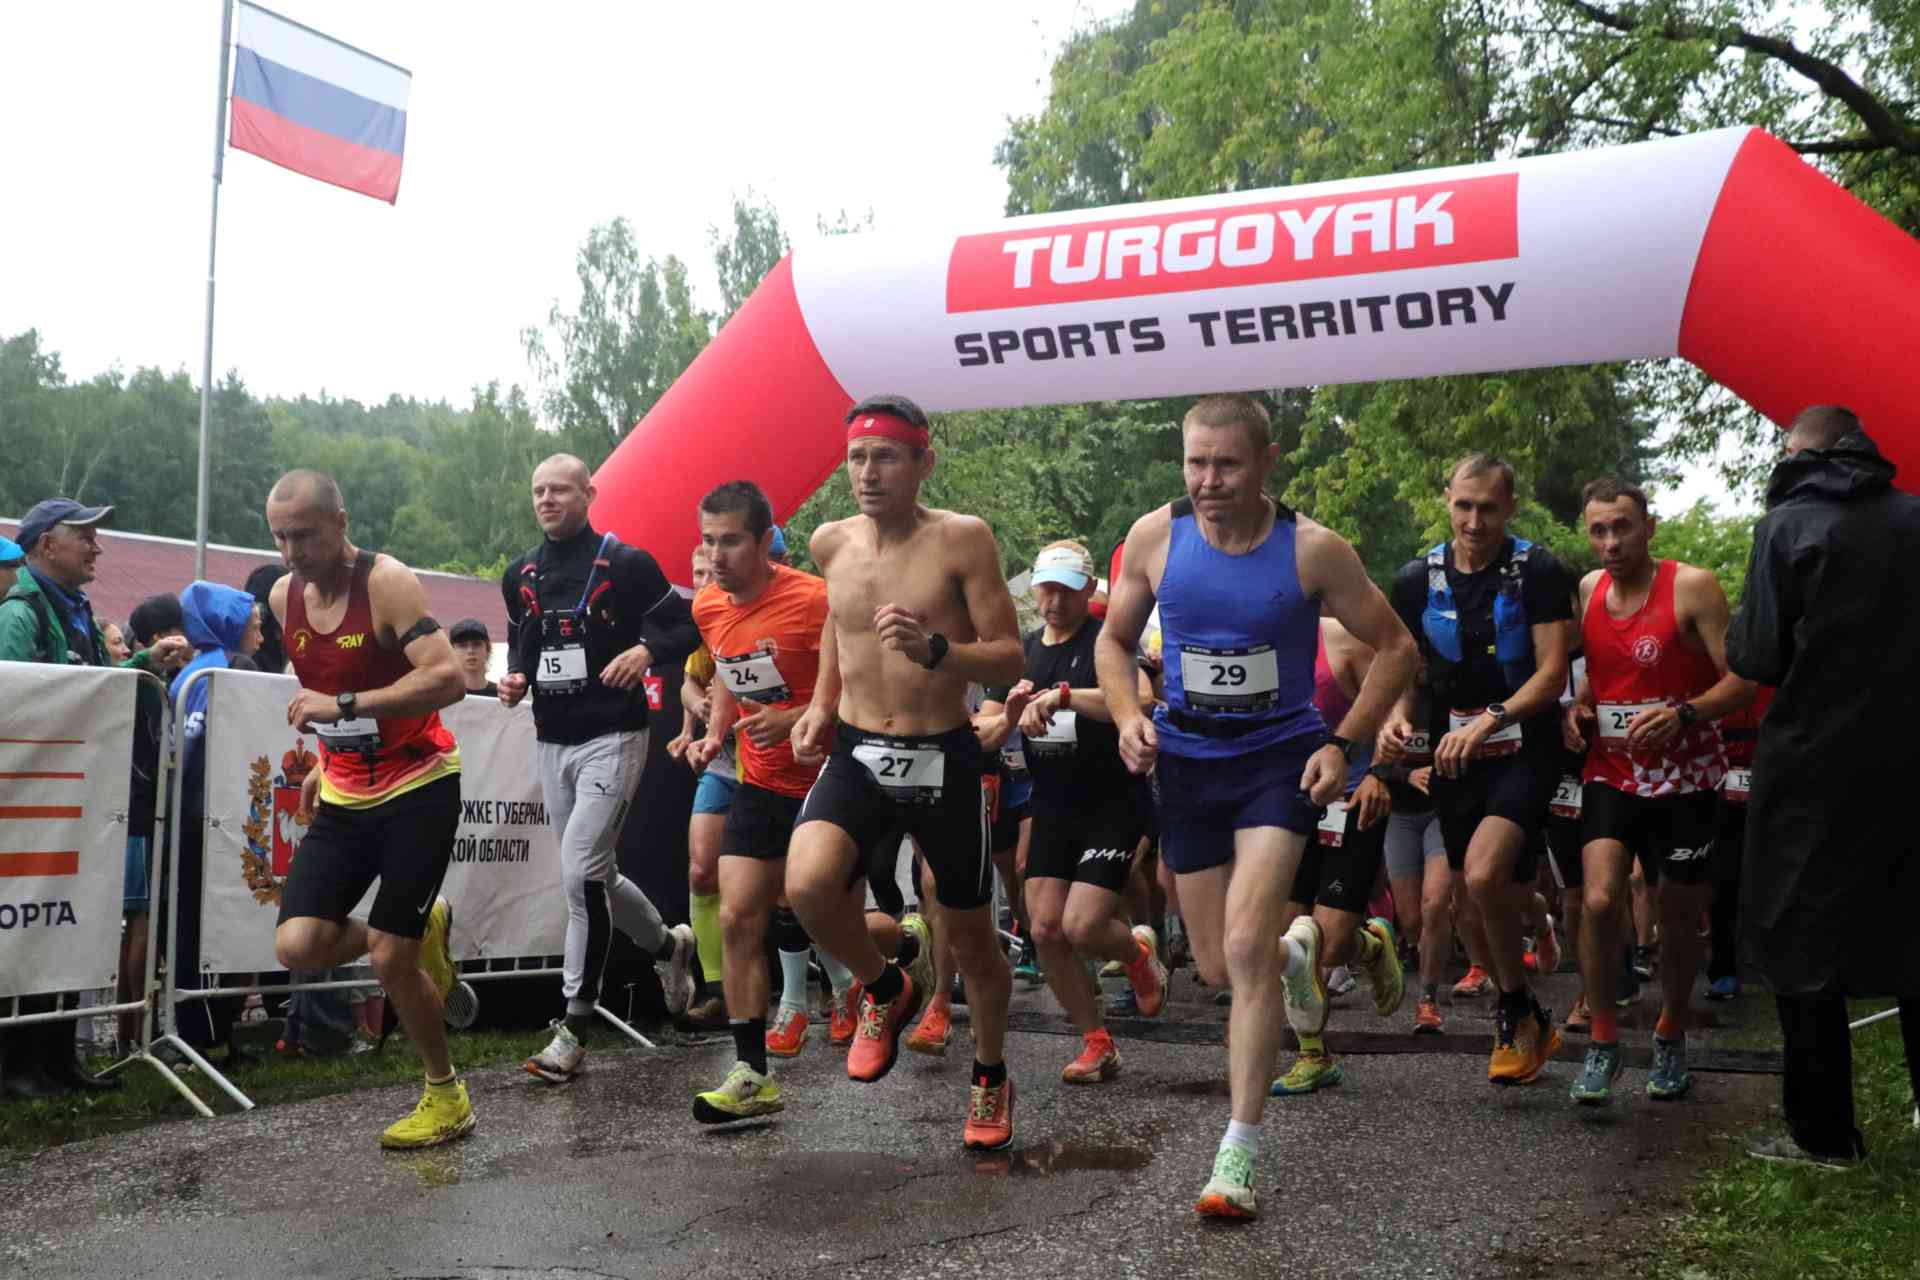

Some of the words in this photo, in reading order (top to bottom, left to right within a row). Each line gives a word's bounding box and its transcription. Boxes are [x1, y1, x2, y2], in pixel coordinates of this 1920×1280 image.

[1003, 192, 1454, 289] TURGOYAK
[954, 317, 1166, 368] SPORTS
[1189, 282, 1516, 348] TERRITORY
[544, 657, 562, 675] 15
[730, 668, 758, 686] 24
[1210, 664, 1247, 686] 29
[1611, 711, 1640, 730] 25
[880, 756, 914, 778] 27
[457, 799, 493, 825] ЖКЕ
[479, 839, 530, 863] ОБЛАСТИ
